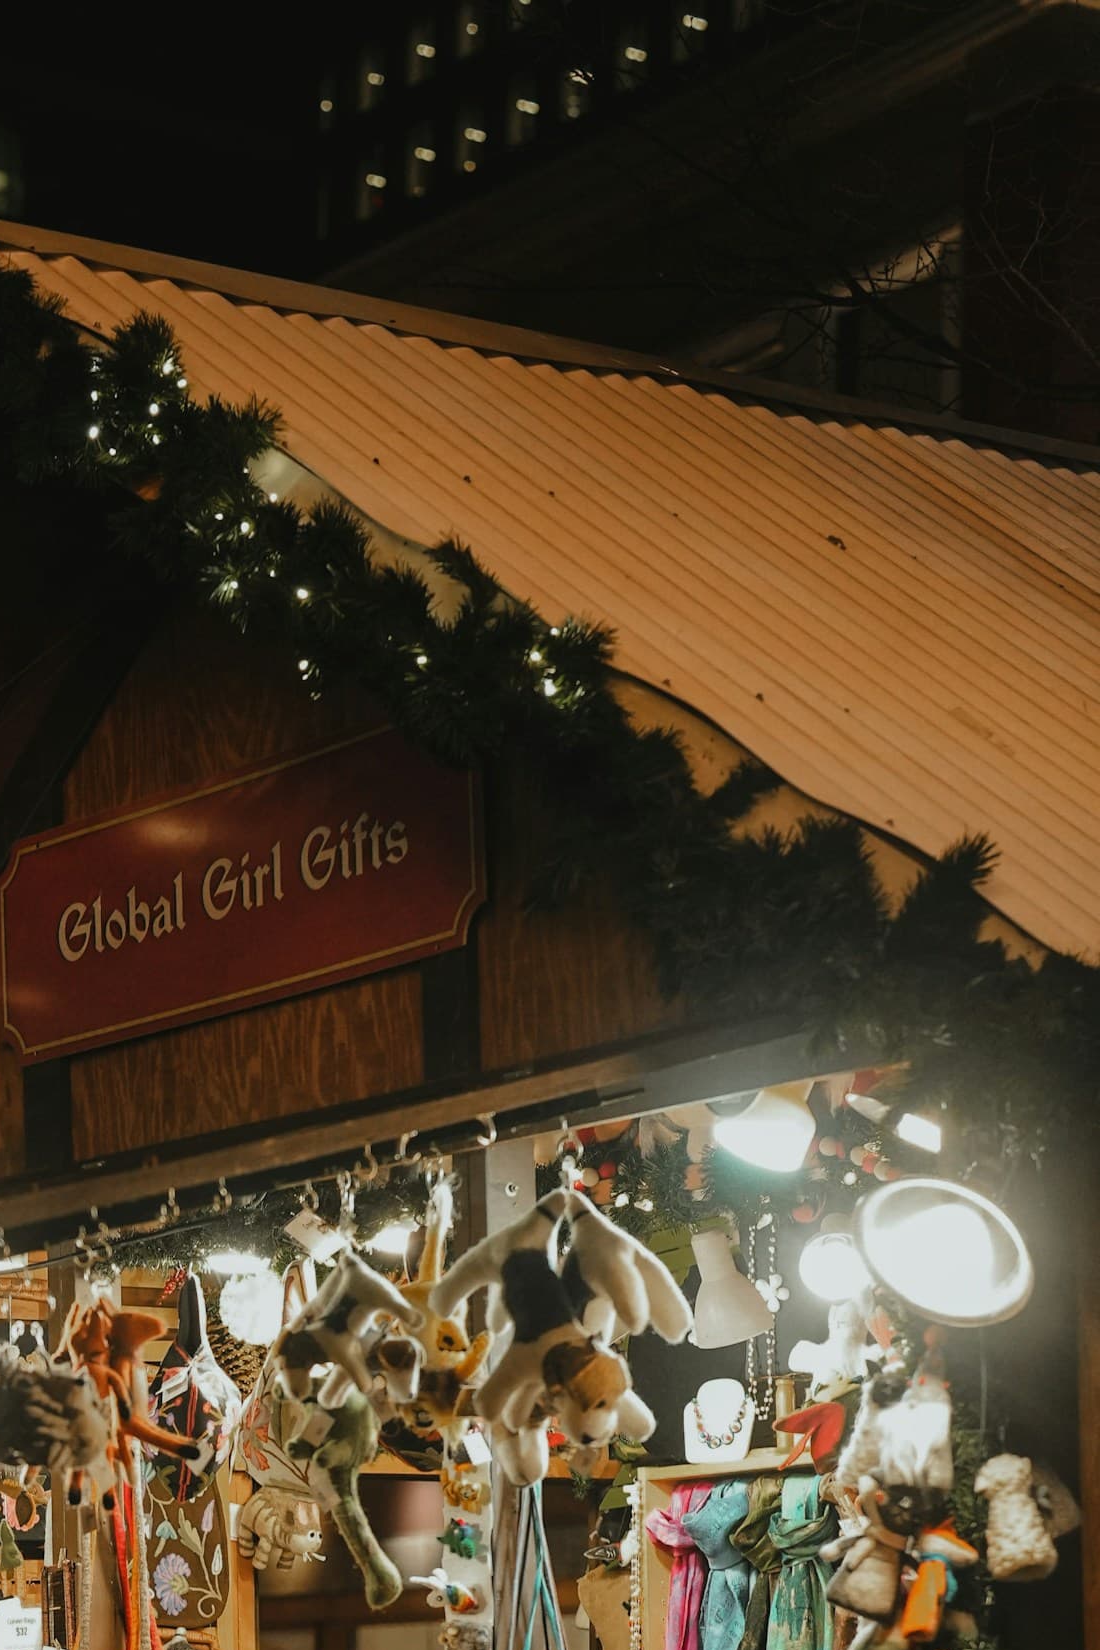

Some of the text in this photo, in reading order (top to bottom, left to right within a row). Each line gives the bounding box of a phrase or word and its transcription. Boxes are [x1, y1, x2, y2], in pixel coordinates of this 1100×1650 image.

[58, 810, 410, 963] Global Girl Gifts
